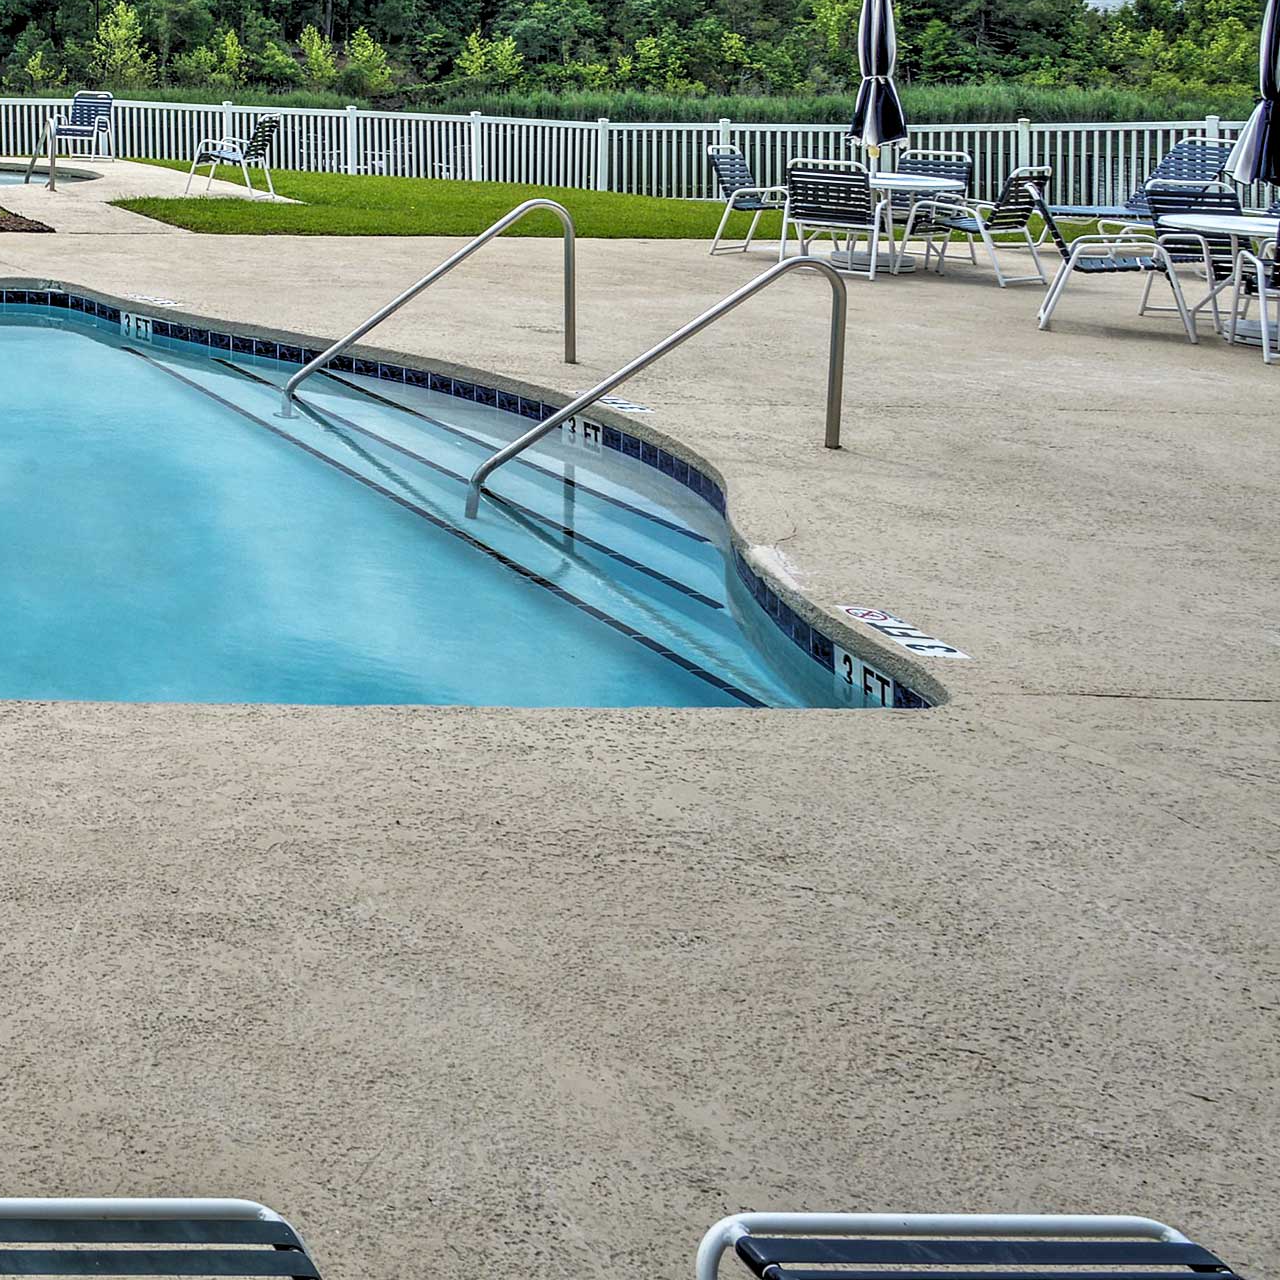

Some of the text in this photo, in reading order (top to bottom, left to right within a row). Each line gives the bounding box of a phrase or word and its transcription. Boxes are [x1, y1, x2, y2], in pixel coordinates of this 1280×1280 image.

[583, 421, 601, 442] FT
[842, 654, 891, 707] 3 FT
